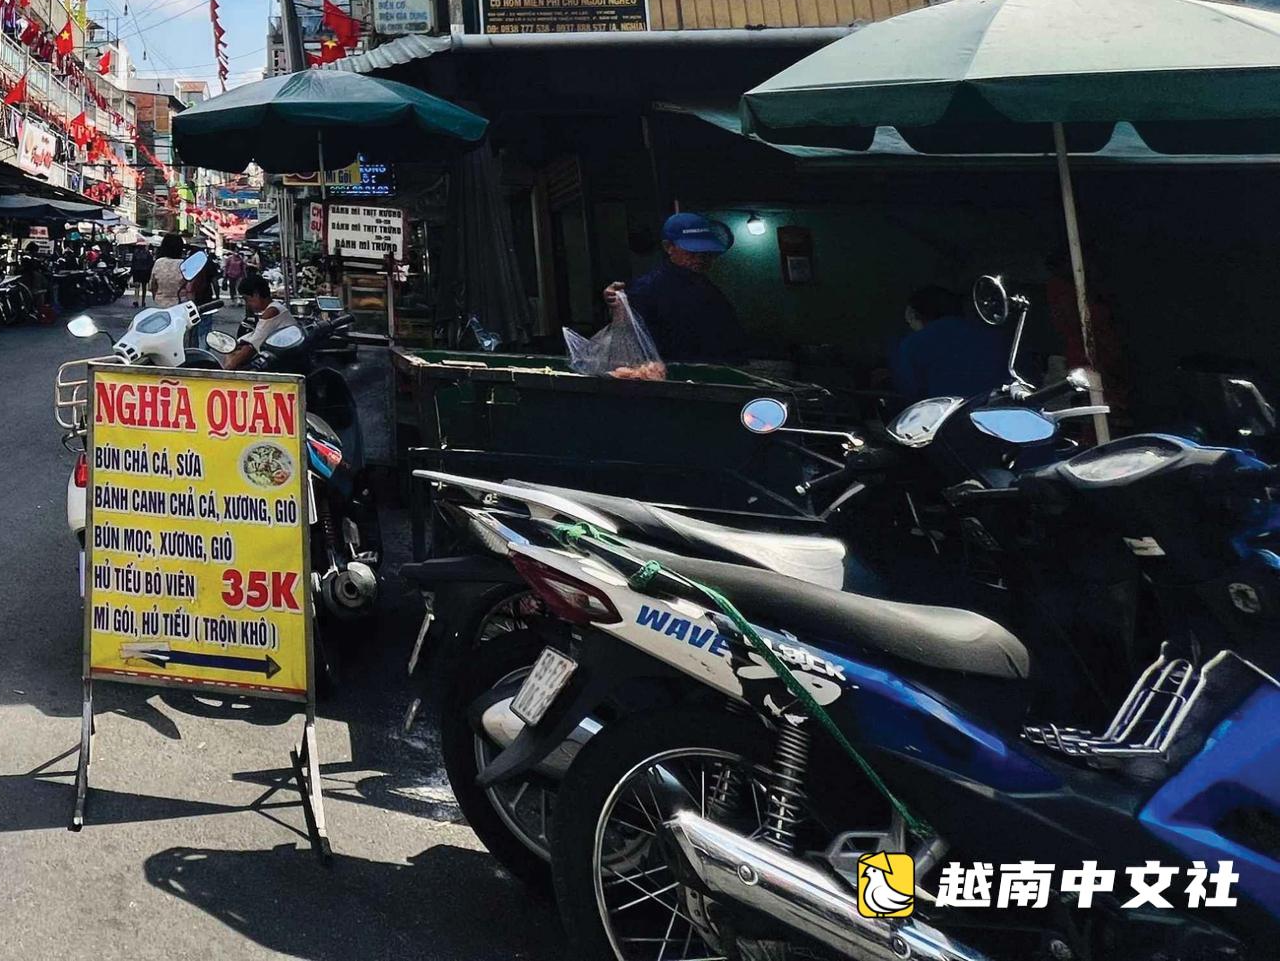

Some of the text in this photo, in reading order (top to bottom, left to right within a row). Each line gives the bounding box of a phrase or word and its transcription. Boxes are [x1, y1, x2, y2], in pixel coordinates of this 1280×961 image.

[95, 379, 296, 438] NGHĨA QUÁN
[95, 443, 202, 478] BÚN CHẢ CÁ, SỨA
[95, 482, 297, 526] BÁNH CANH CHẢ CÁ, XƯƠNG, GIÒ
[94, 521, 233, 562] BÚN MỌC, XƯƠNG, GIÒ
[94, 558, 111, 589] HỦ
[114, 562, 141, 593] TIẾU
[166, 570, 195, 598] VIÊN
[221, 569, 300, 610] 35K
[94, 601, 110, 631] MÌ
[113, 603, 138, 637] GÓI,
[142, 604, 159, 636] HỦ
[163, 606, 190, 639] TIẾU
[202, 617, 237, 649] TRỘN
[241, 616, 270, 647] KHÔ
[636, 605, 731, 658] WAVE
